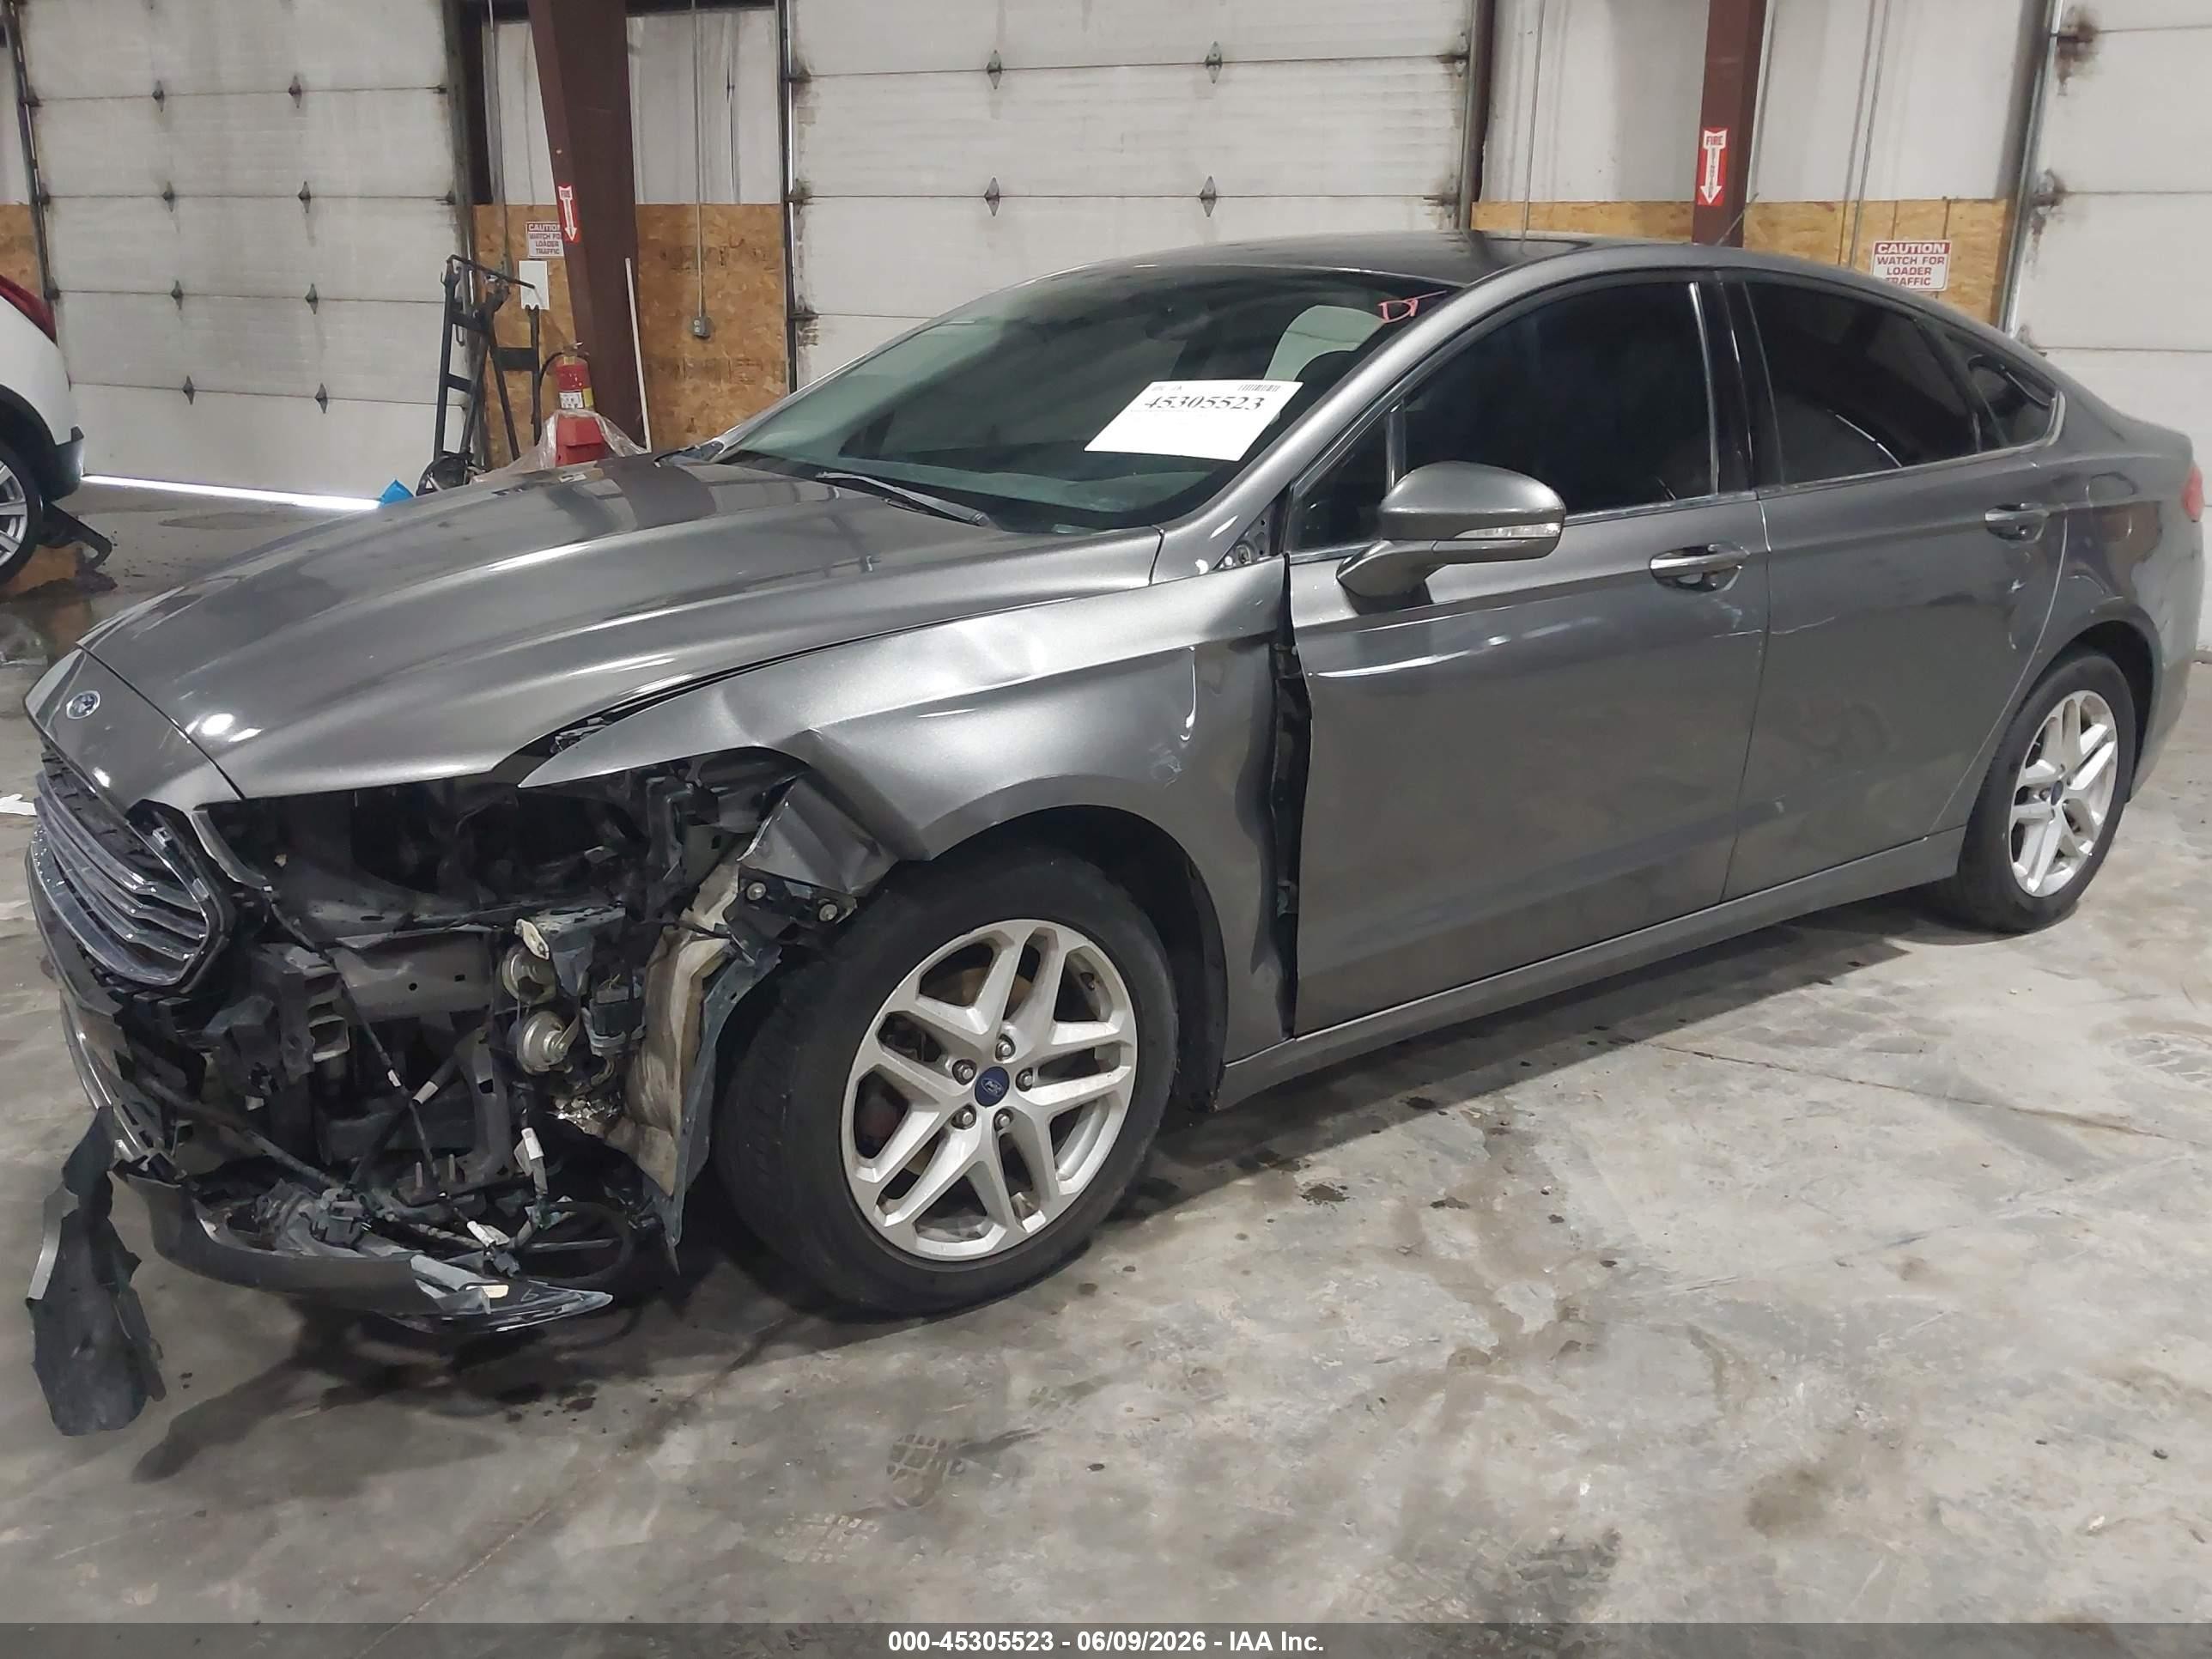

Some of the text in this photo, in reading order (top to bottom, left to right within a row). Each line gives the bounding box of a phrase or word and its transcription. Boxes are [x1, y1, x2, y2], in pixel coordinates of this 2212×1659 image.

[1706, 136, 1723, 145] FIRE
[1877, 243, 1946, 254] CAUTION
[1877, 256, 1945, 265] WATCH FOR
[1887, 267, 1932, 276] LOADER
[1144, 395, 1265, 410] 45305523
